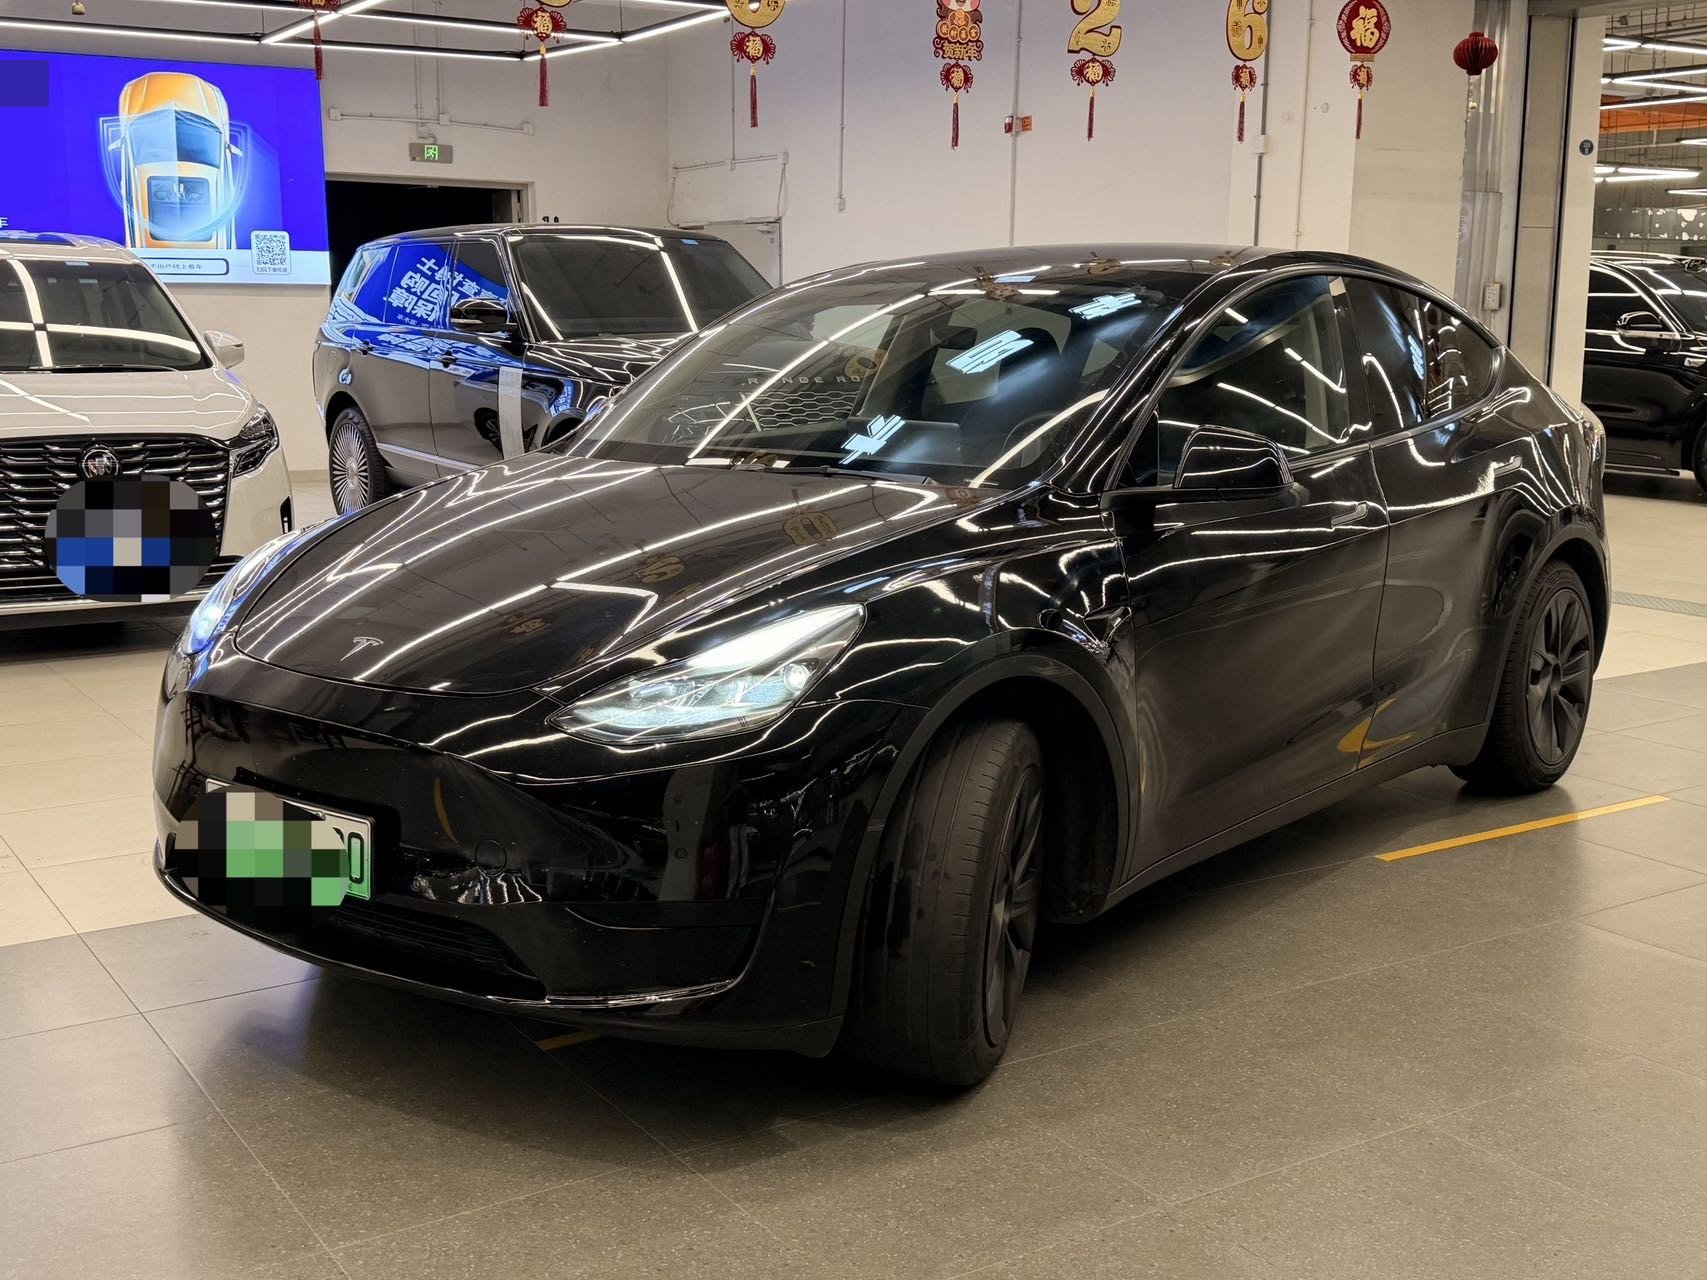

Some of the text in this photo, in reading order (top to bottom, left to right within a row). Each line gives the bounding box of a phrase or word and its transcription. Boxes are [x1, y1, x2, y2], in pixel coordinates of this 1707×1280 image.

[1350, 5, 1380, 48] 福
[744, 35, 763, 59] 福
[943, 41, 978, 60] 贺新年
[1084, 62, 1103, 83] 福
[747, 376, 824, 384] RNGE
